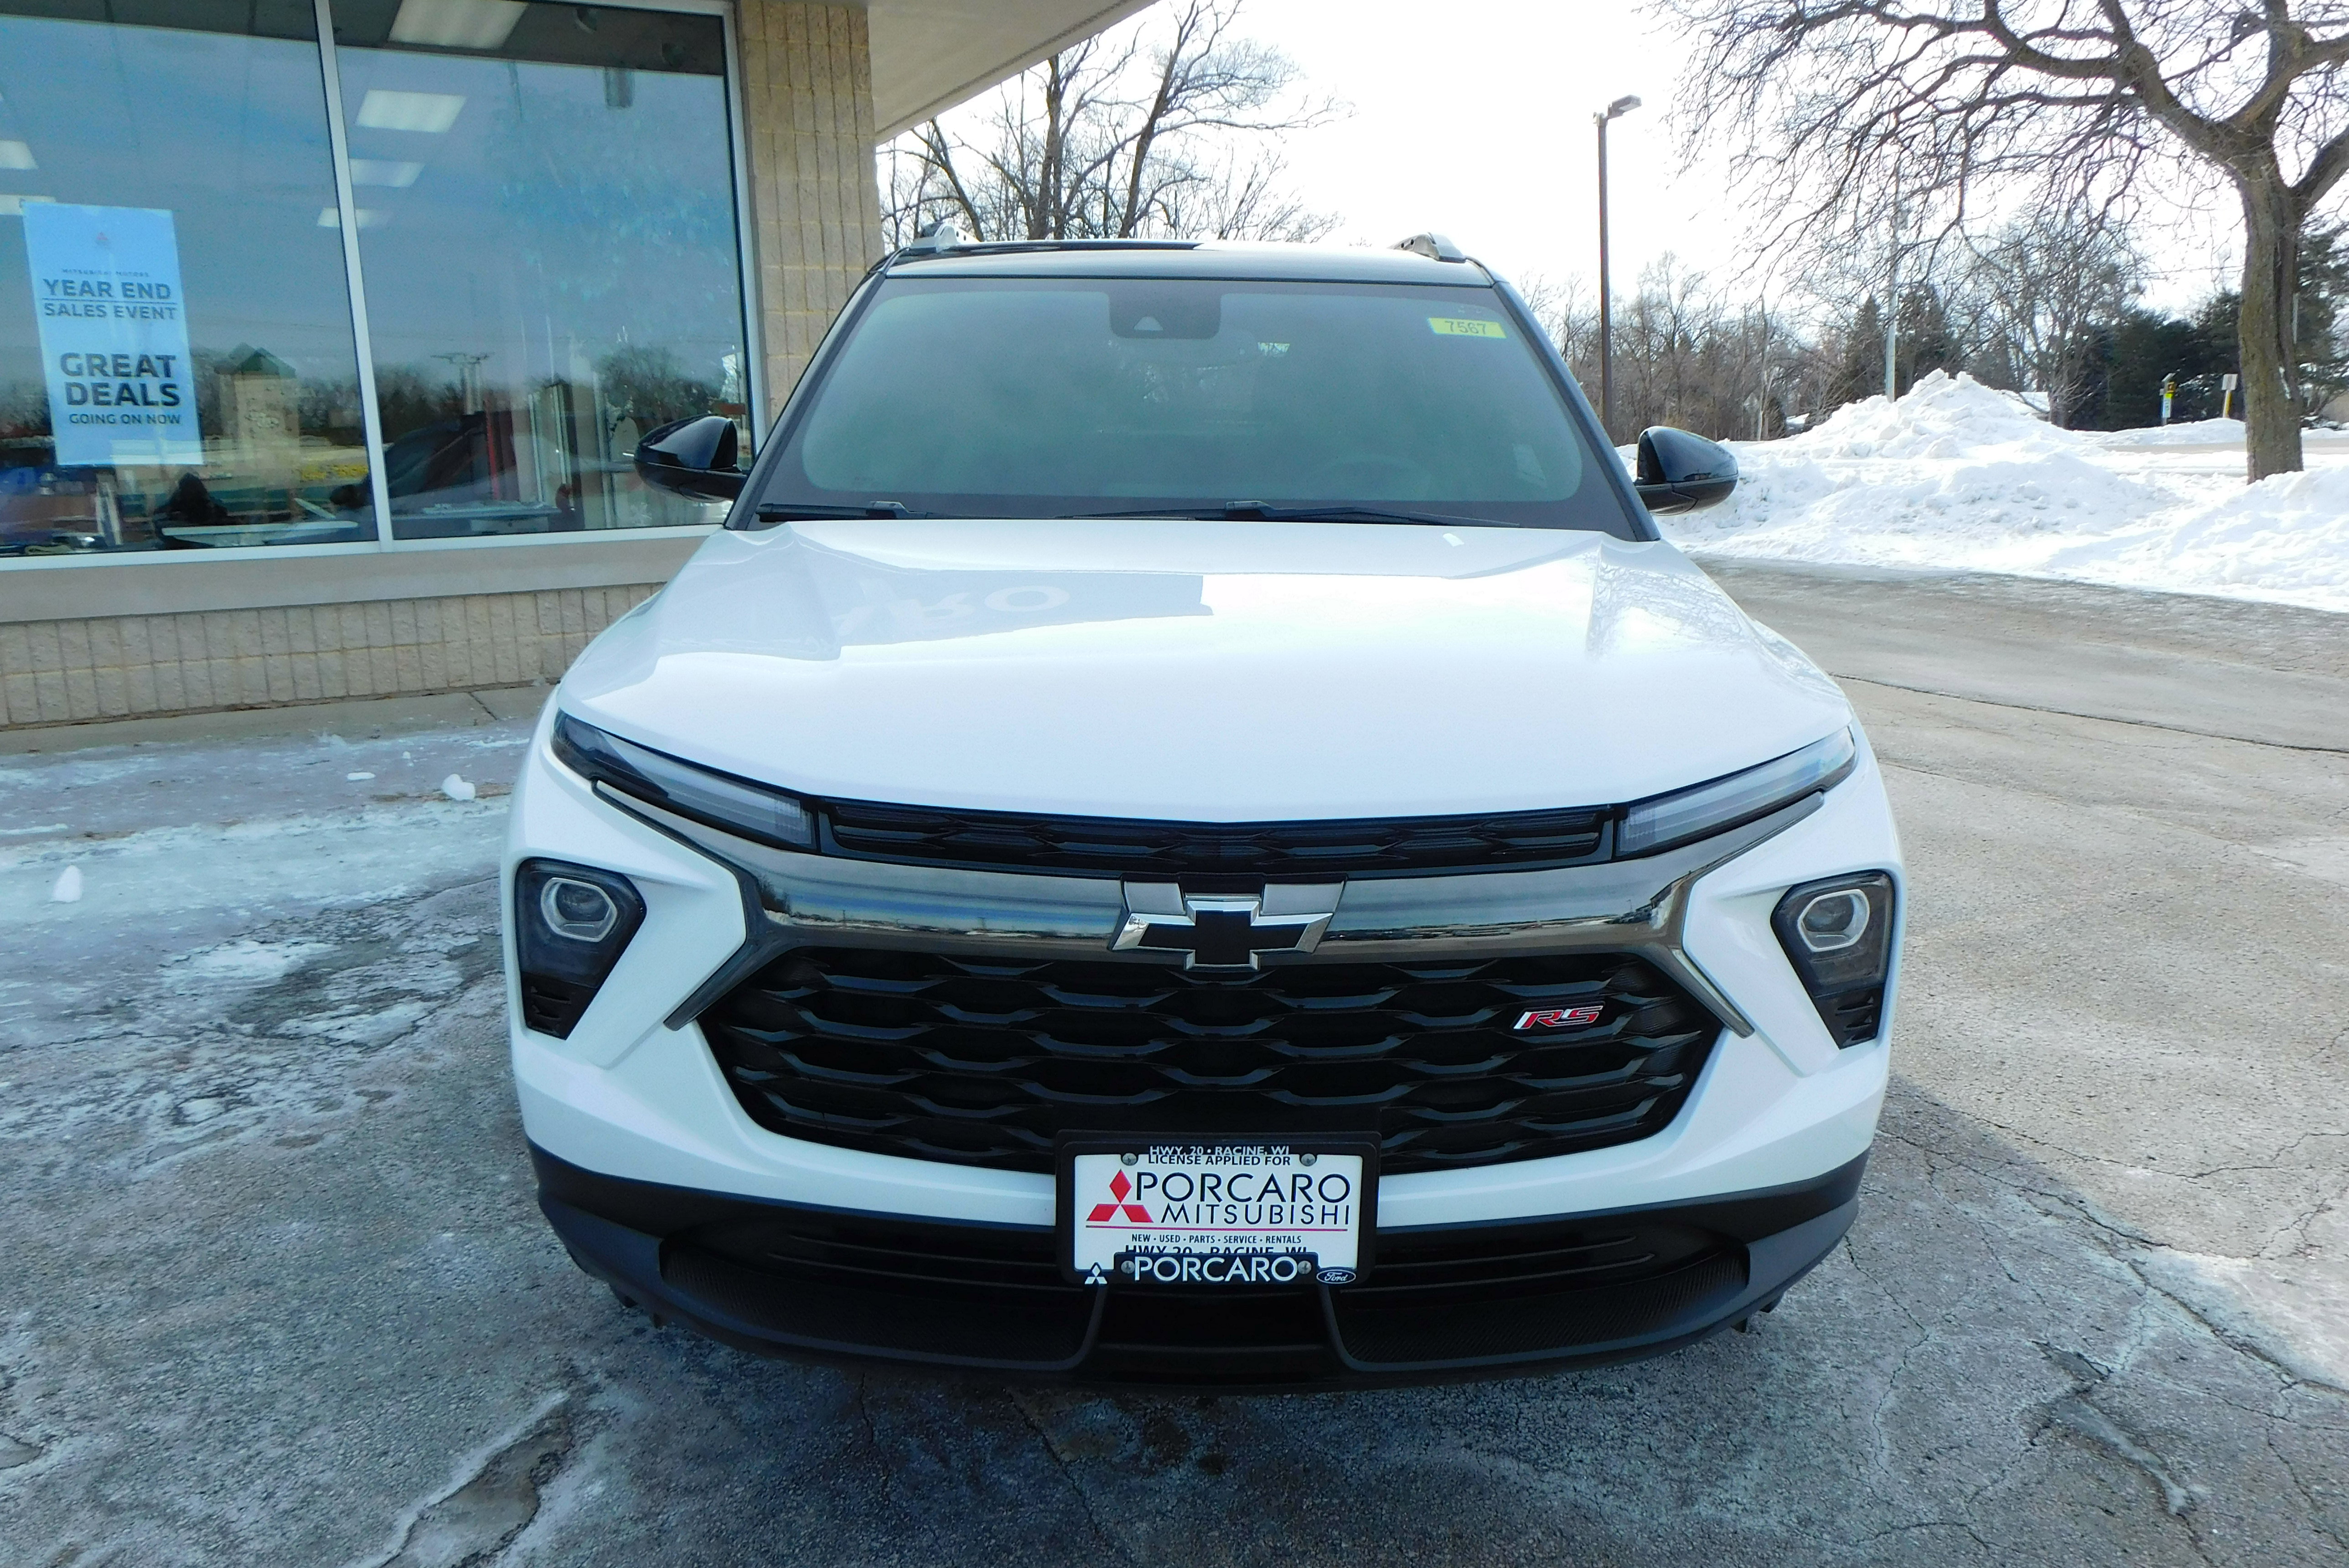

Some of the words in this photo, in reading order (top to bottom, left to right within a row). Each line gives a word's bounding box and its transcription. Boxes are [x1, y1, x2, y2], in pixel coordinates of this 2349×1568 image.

[43, 279, 114, 297] YEAR
[121, 282, 171, 299] END
[44, 303, 107, 318] SALES
[114, 305, 177, 320] EVENT
[1444, 320, 1486, 335] 7567
[60, 352, 176, 378] GREAT
[65, 382, 181, 406] DEALS
[69, 413, 115, 424] GOING
[120, 413, 142, 424] ON
[146, 413, 181, 424] NOW
[1513, 1006, 1604, 1029] RS
[1190, 1146, 1204, 1155] 20
[1271, 1145, 1289, 1155] WI
[1149, 1155, 1201, 1165] LICENSE
[1205, 1155, 1261, 1165] APPLIED
[1264, 1156, 1291, 1166] FOR
[1136, 1171, 1350, 1203] PORCARO
[1160, 1202, 1350, 1225] MITSUBISHI
[1131, 1233, 1151, 1243] NEW
[1159, 1234, 1181, 1243] USED
[1189, 1235, 1215, 1243] PARTS
[1223, 1235, 1257, 1244] SERVICE
[1266, 1235, 1302, 1244] RENTALS
[1134, 1256, 1299, 1282] PORCARO
[1324, 1272, 1348, 1281] Ford
